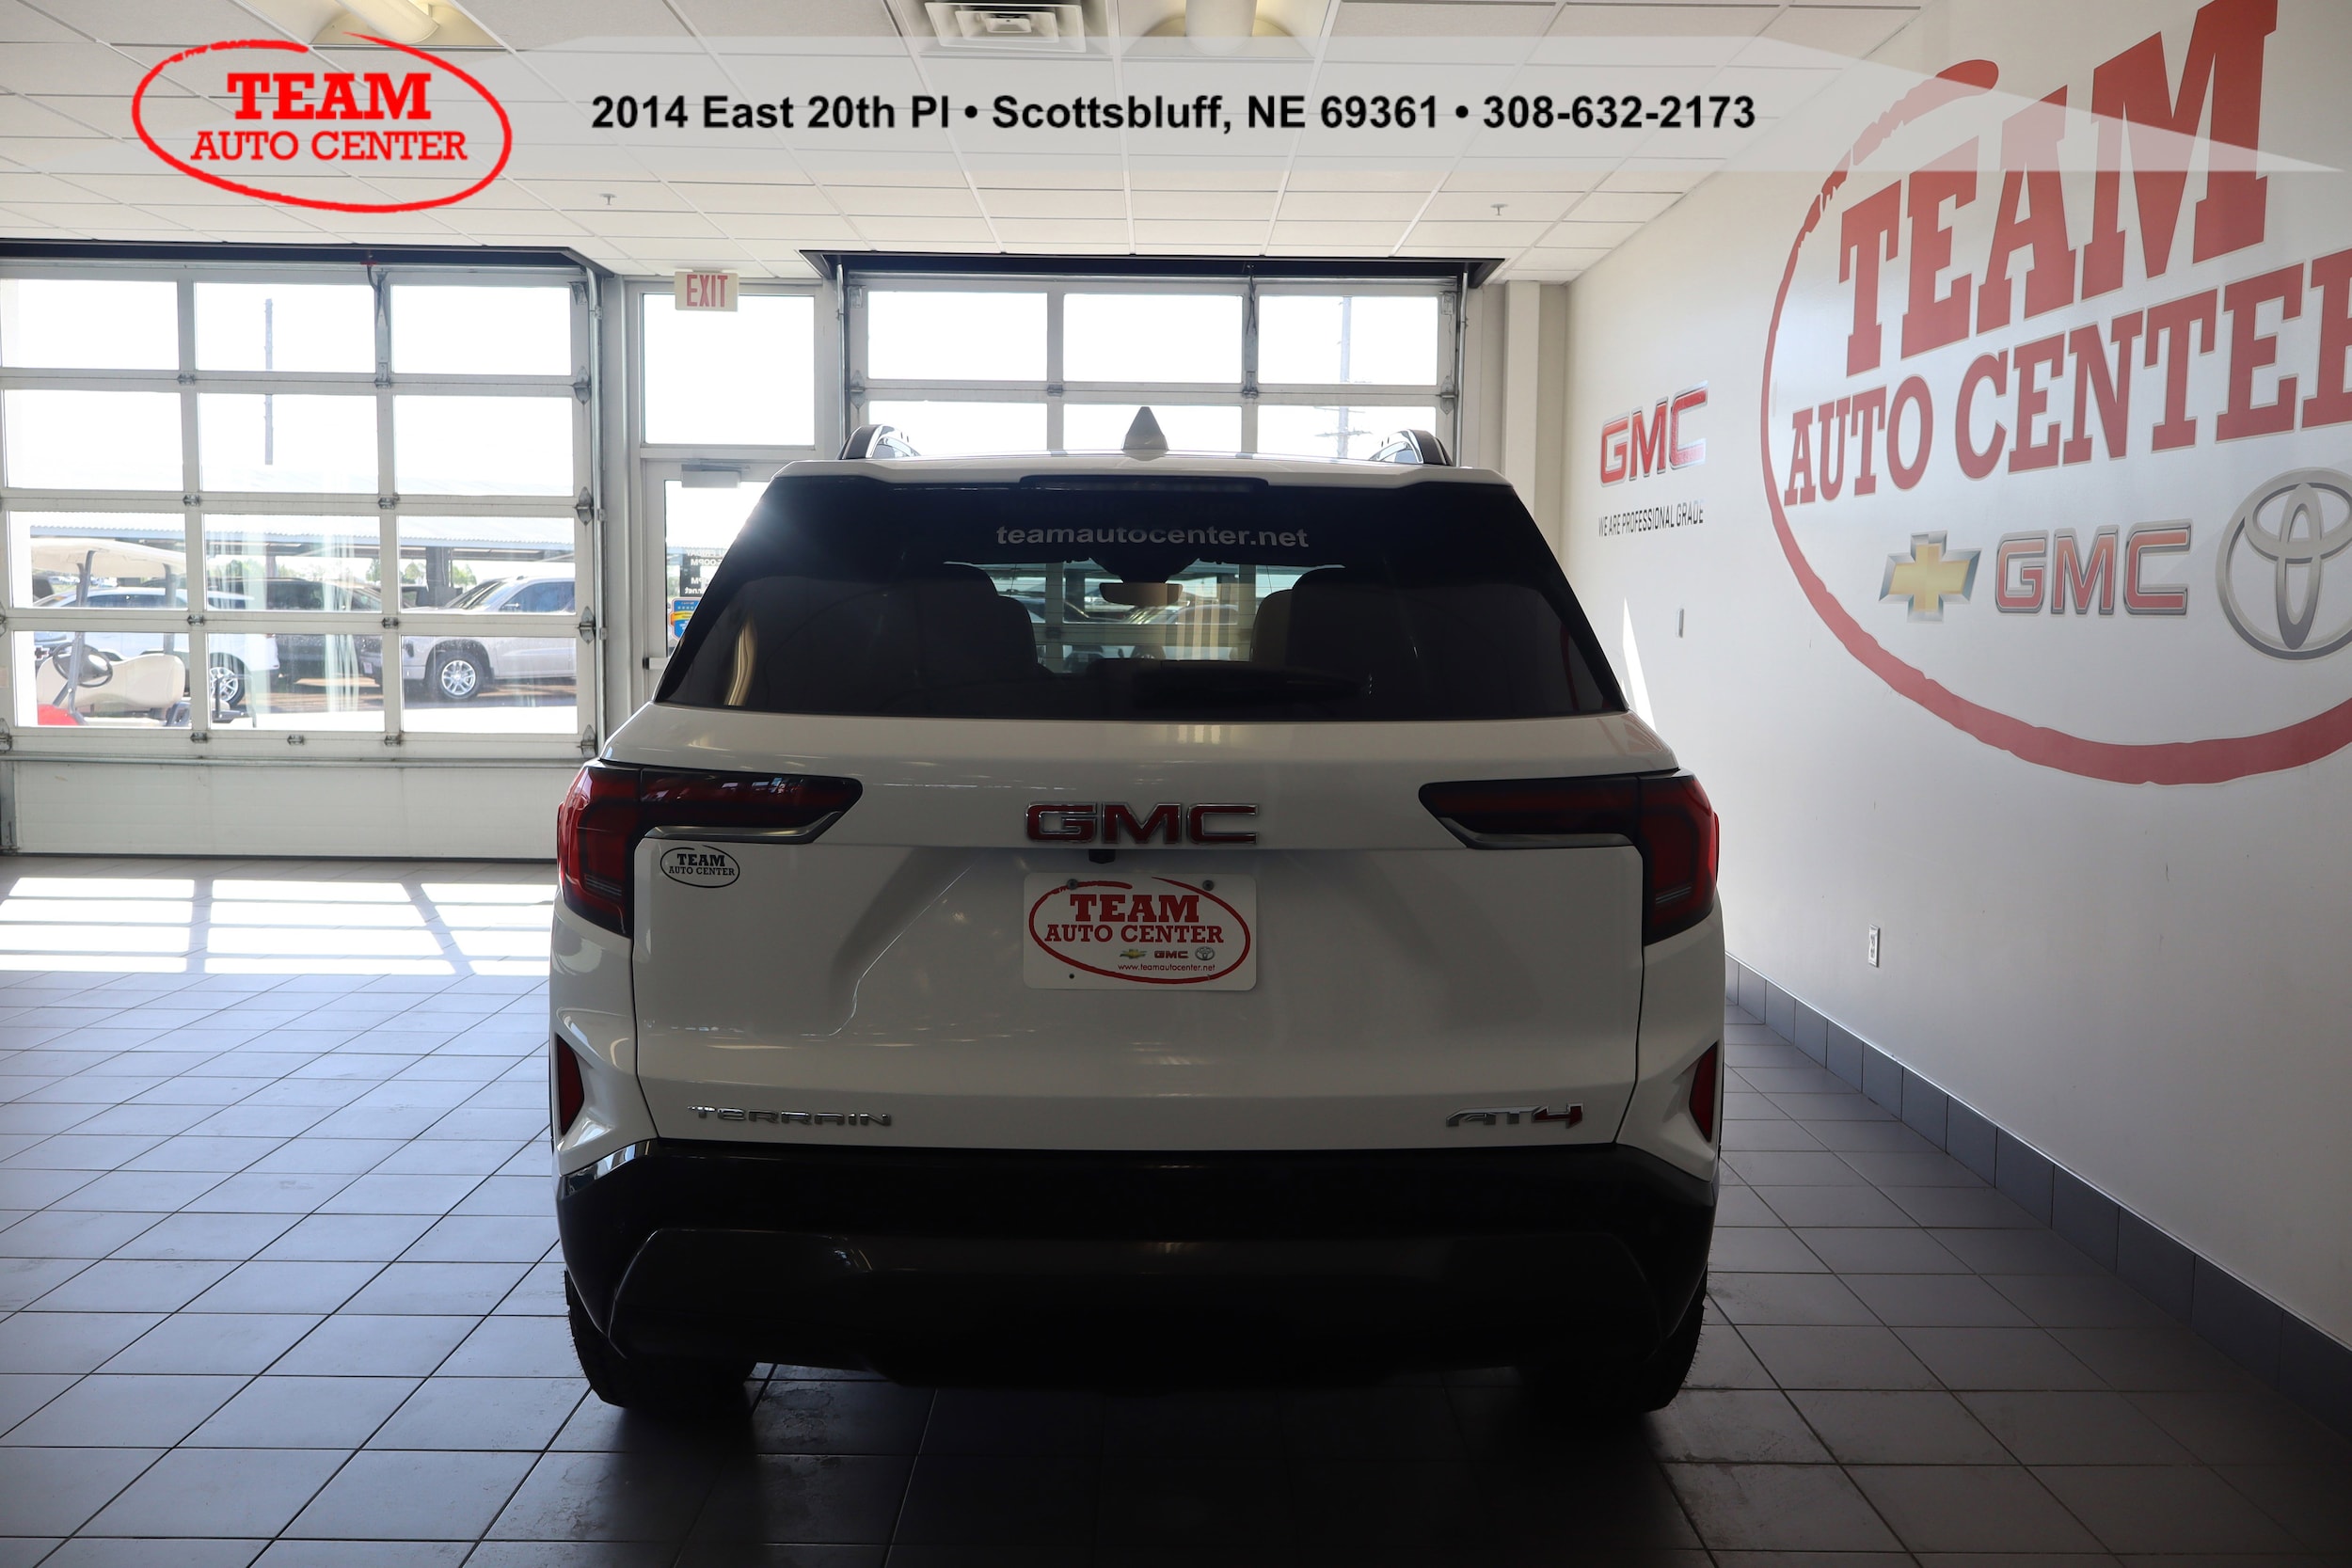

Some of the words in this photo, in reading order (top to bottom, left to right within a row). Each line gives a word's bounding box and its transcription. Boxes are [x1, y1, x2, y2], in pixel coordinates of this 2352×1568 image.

[1839, 0, 2279, 379] TEAM
[687, 274, 728, 308] EXIT
[1600, 380, 1708, 487] GMC
[1783, 373, 1933, 507] AUTO
[1598, 515, 1608, 537] WE
[1609, 514, 1620, 536] ARE
[1622, 504, 1675, 534] PROFESSIONAL
[1676, 499, 1704, 527] GRADE
[995, 525, 1310, 548] teamautocenter.net
[1994, 520, 2194, 617] GMC
[1025, 802, 1259, 845] GMC
[669, 865, 693, 875] AUTO
[696, 867, 735, 876] CENTER
[677, 853, 725, 866] TEAM
[1070, 894, 1200, 923] TEAM
[1044, 924, 1113, 942] AUTO
[1120, 925, 1225, 943] CENTER
[1118, 963, 1216, 972] www.teamautocenter.net
[1153, 950, 1189, 959] GMC
[687, 1105, 892, 1127] TERRAIN
[1446, 1103, 1583, 1129] AT4
